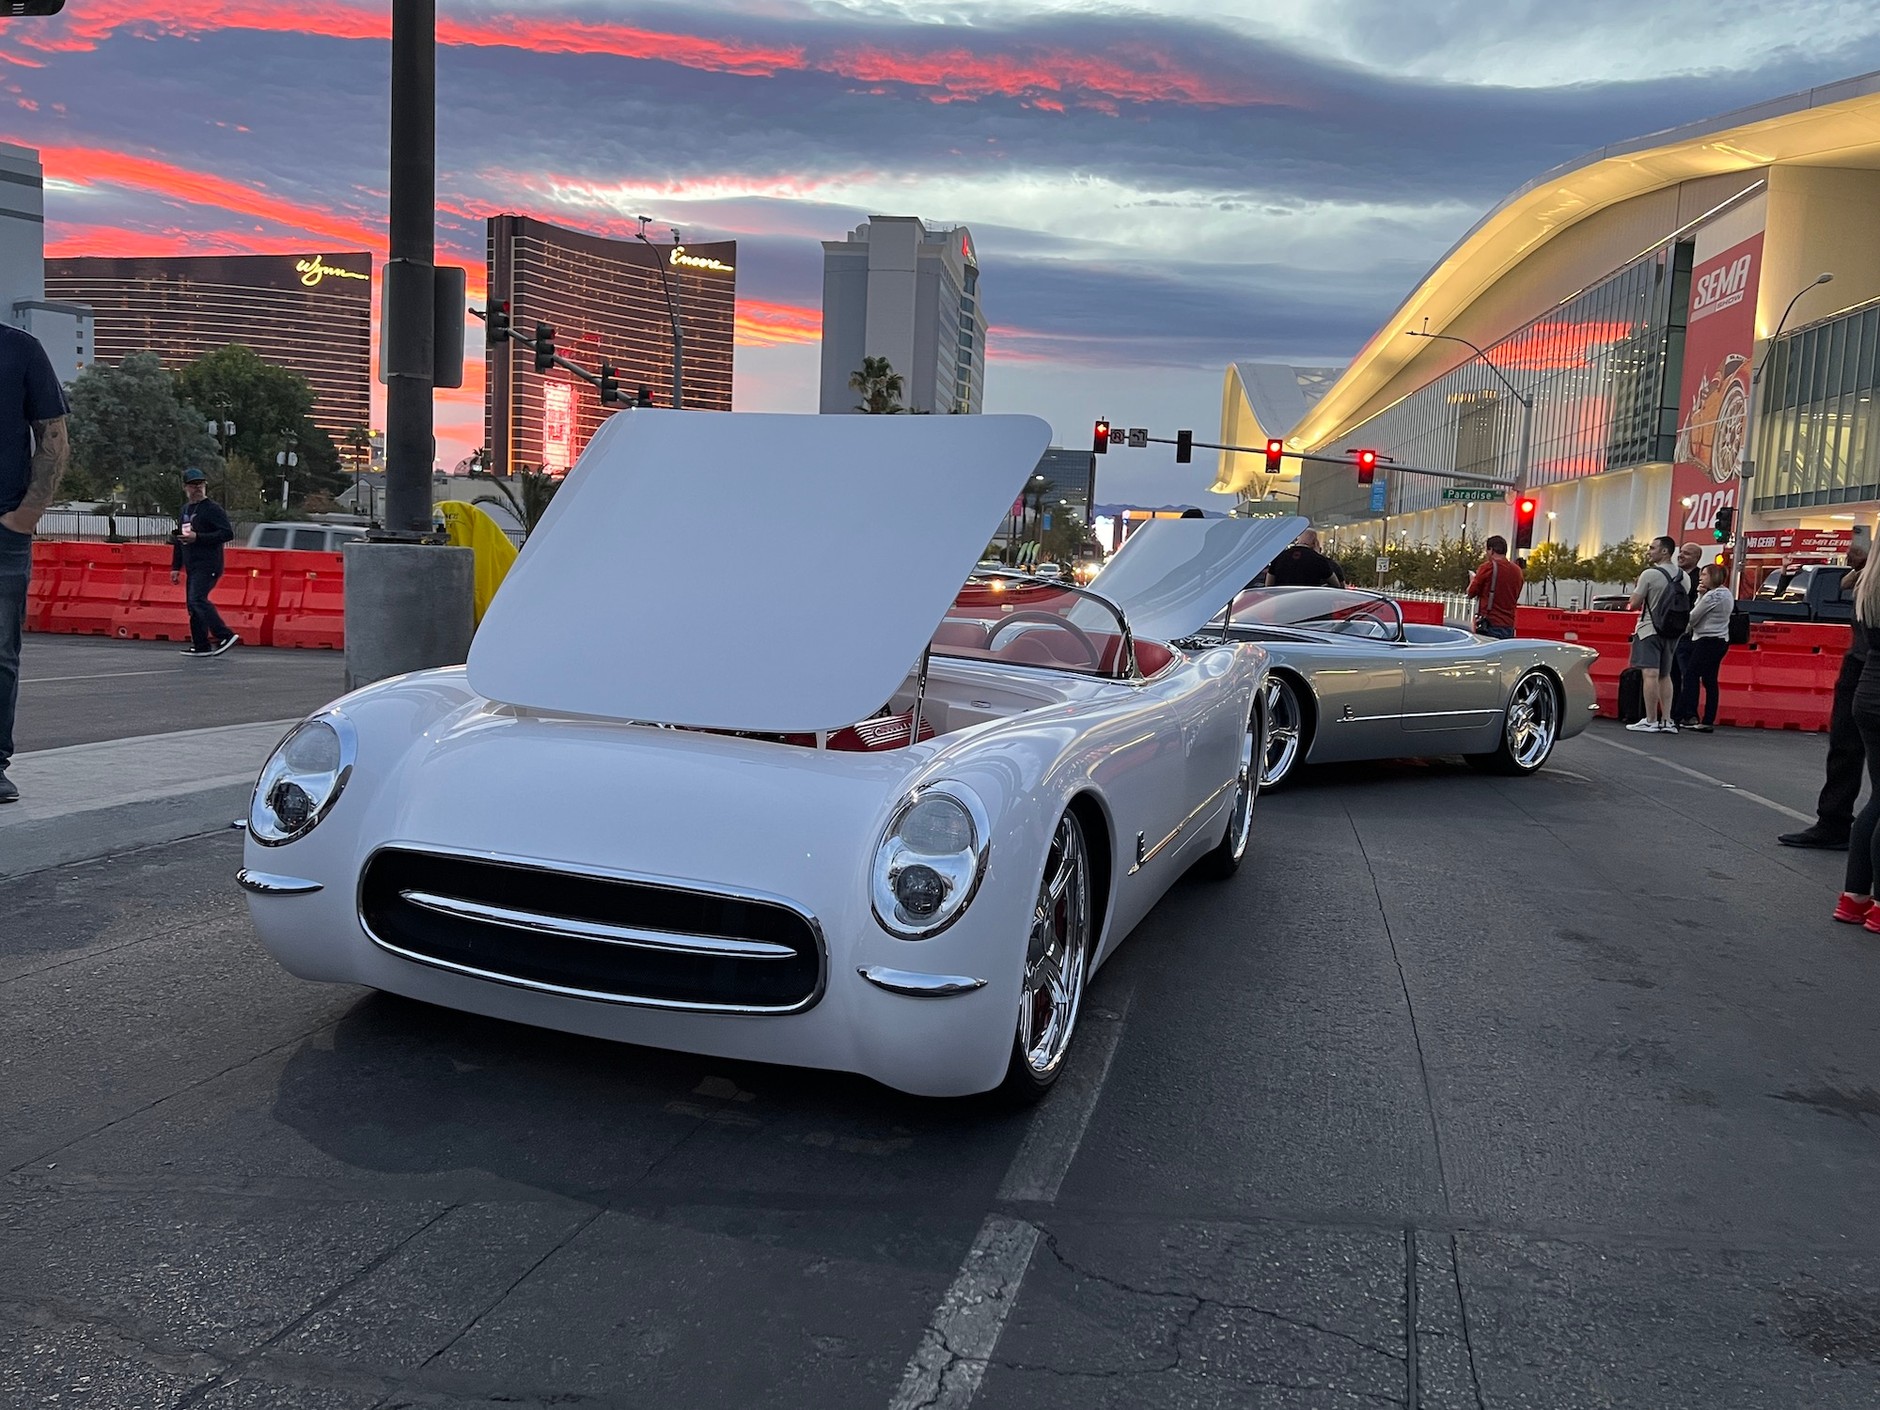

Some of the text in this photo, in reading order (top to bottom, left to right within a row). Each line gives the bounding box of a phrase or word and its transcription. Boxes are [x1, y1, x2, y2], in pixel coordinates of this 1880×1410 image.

[669, 246, 734, 271] Encore
[1693, 254, 1752, 310] SEMA
[1717, 293, 1743, 309] SHOW
[1447, 489, 1492, 500] Paradise
